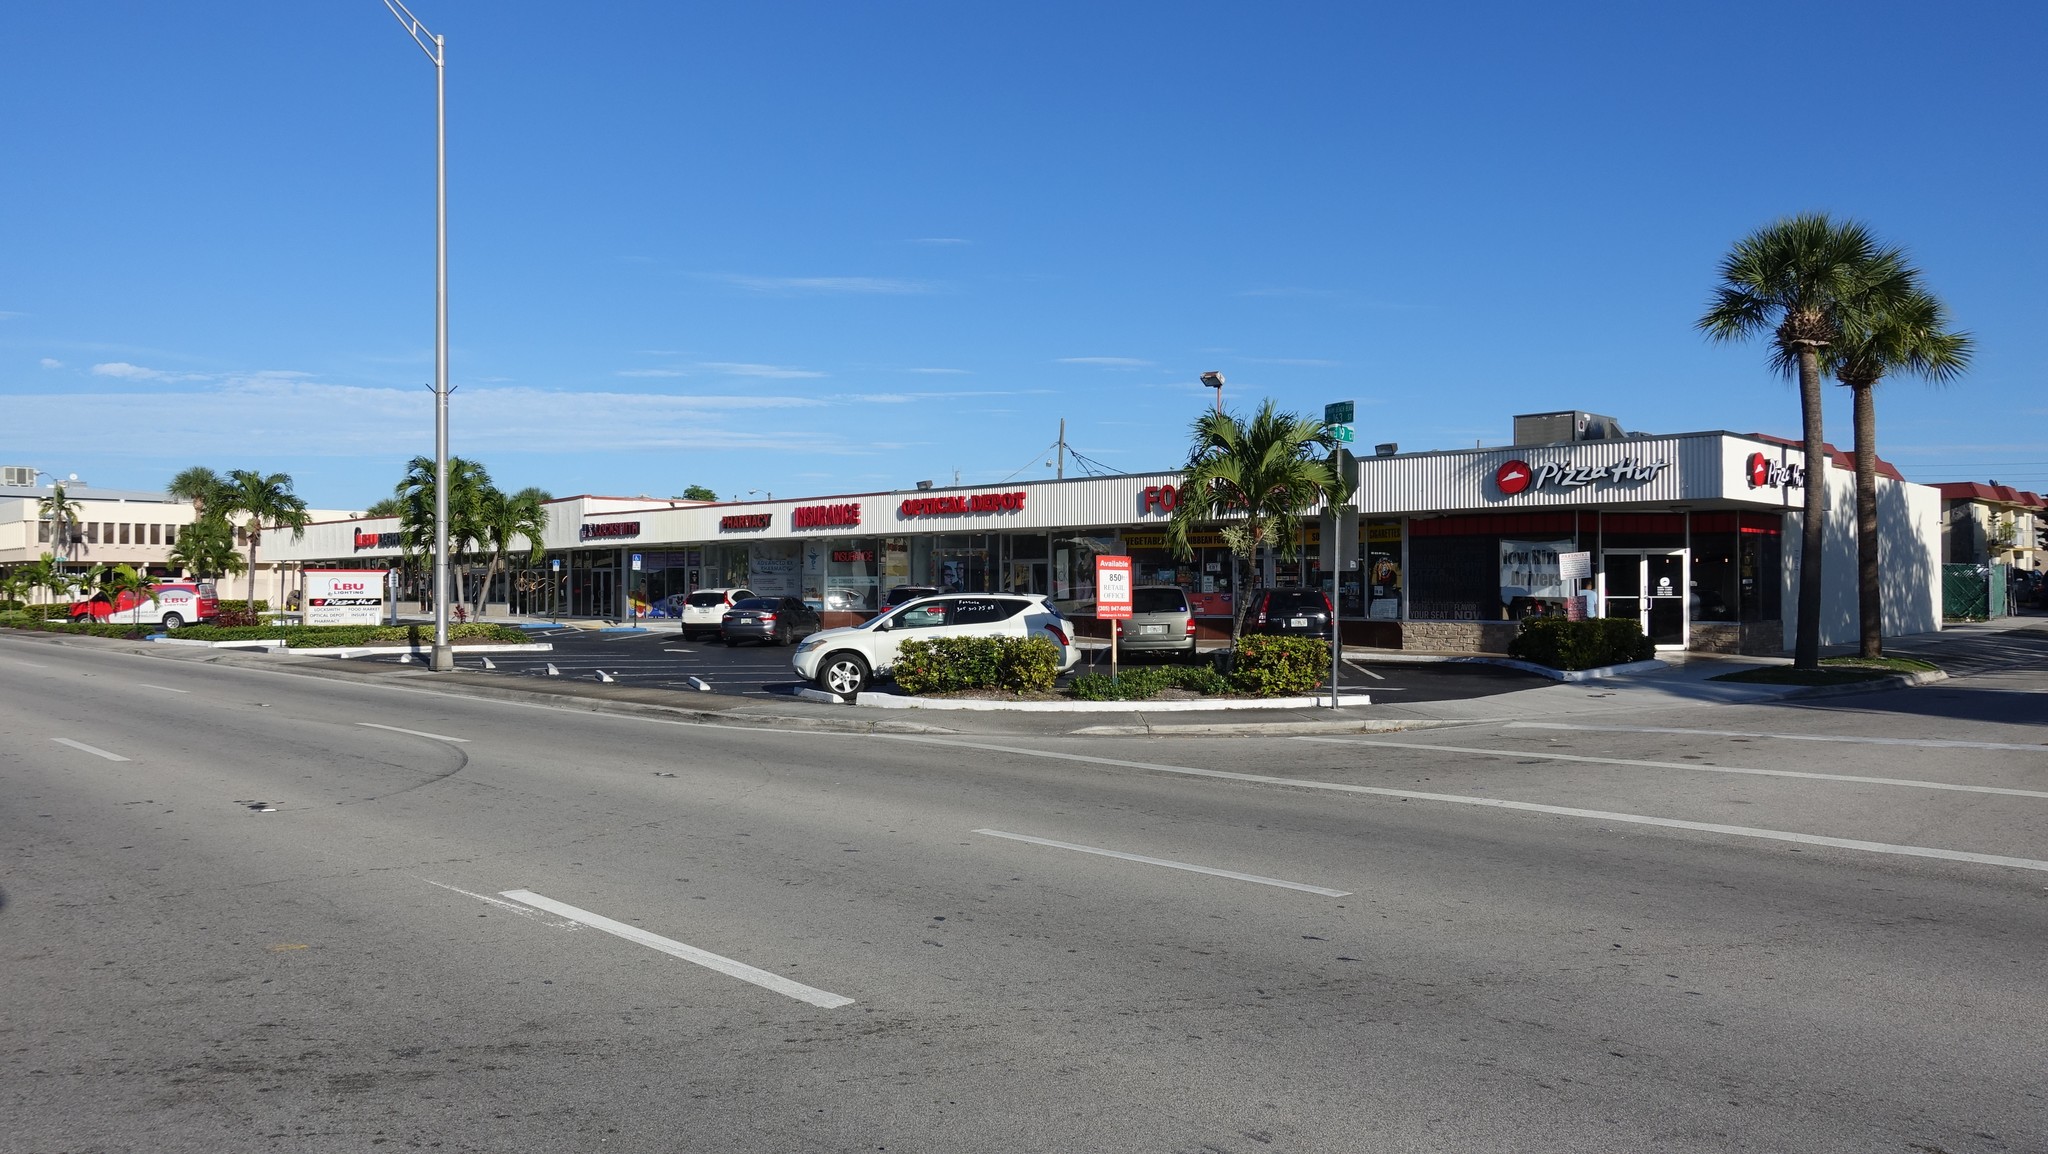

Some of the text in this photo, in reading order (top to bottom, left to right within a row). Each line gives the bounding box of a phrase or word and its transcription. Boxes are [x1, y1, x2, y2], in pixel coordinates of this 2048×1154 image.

[1340, 427, 1345, 440] 9
[1536, 457, 1671, 489] Pizza Hut
[1793, 464, 1805, 488] Hu
[901, 492, 1027, 517] OPTICAL DEPOT
[721, 513, 772, 529] PHARMACY
[794, 503, 862, 529] INSURANCE
[595, 521, 640, 537] LOCKSMITH
[1369, 528, 1401, 539] CIGARETTES
[1125, 535, 1168, 546] VEGETABLE
[833, 551, 874, 562] INSURANCE
[1100, 560, 1129, 568] Available
[1109, 573, 1122, 582] 850
[1511, 571, 1563, 587] Drivers
[333, 583, 364, 591] LBU
[324, 598, 379, 606] Pizza Hut
[1454, 603, 1477, 611] FLAVOR
[1409, 611, 1429, 619] YOUR
